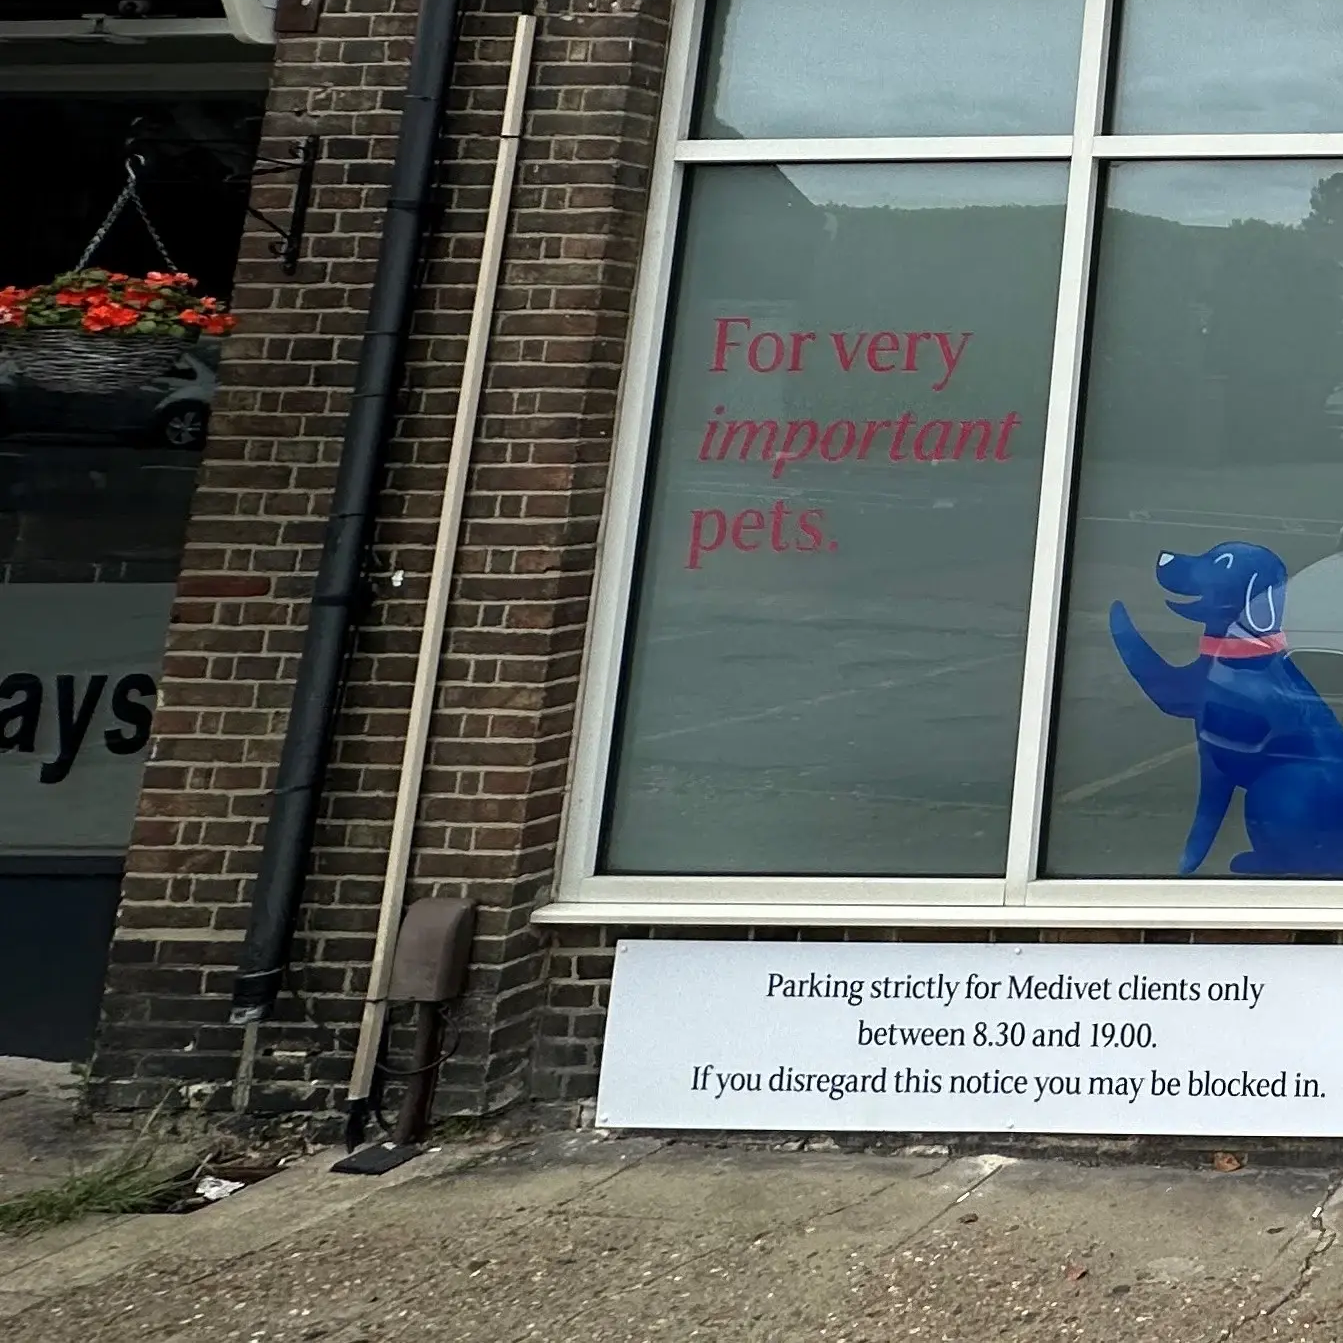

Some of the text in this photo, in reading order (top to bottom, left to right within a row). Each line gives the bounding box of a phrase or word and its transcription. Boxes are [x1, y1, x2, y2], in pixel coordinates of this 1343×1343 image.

[708, 317, 974, 391] For very
[697, 405, 1022, 479] important
[684, 499, 839, 570] pets.
[767, 973, 1264, 1009] Parking strictly for Medivet clients only
[859, 1020, 1156, 1048] between 8.30 and 19.00.
[691, 1065, 1325, 1103] If you disregard this notice you may be blocked in.
